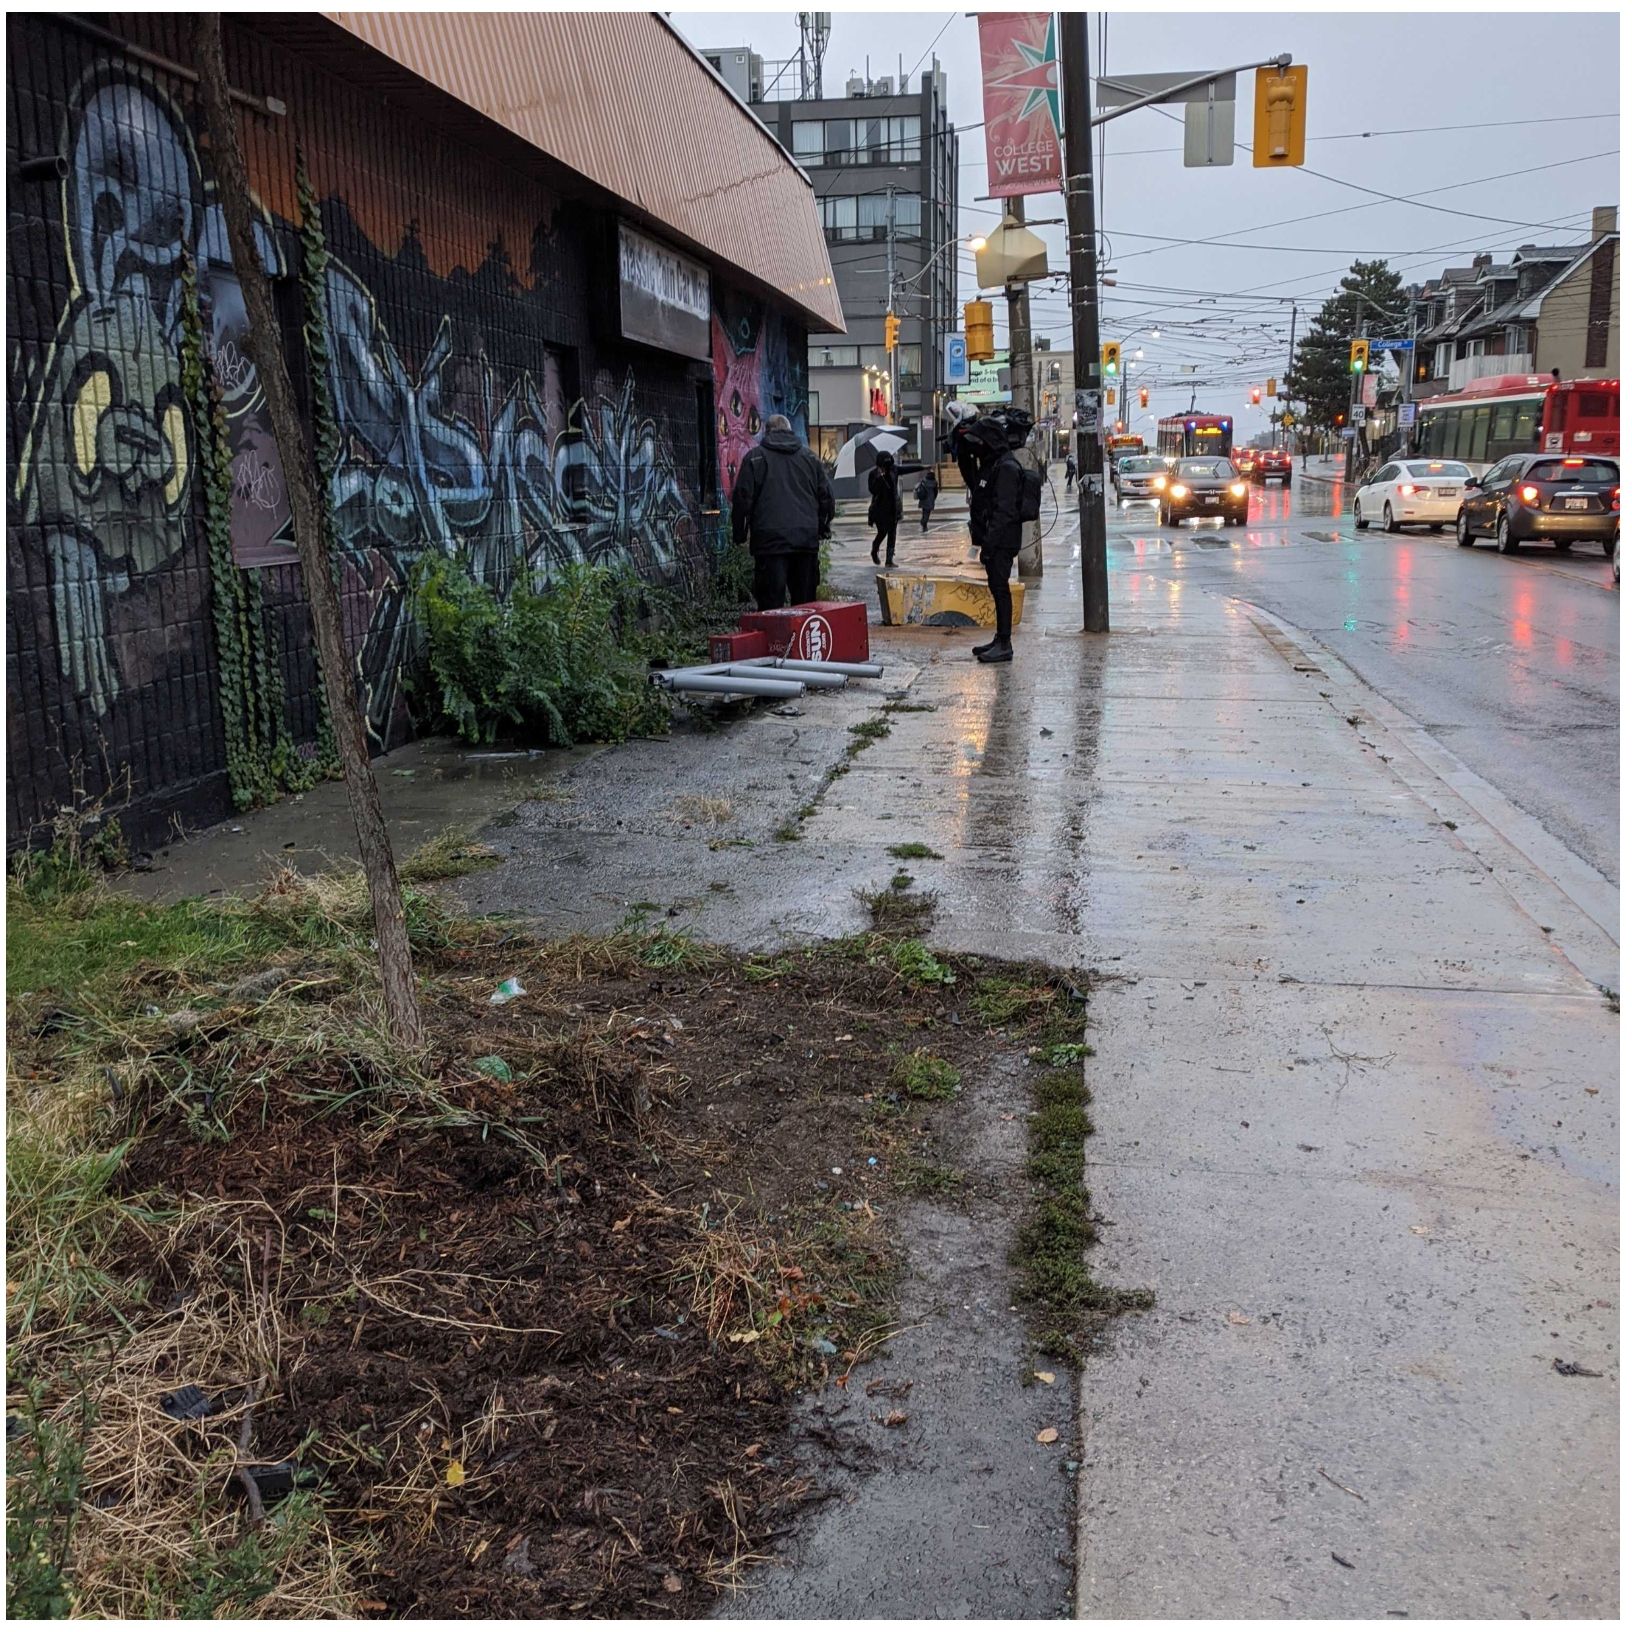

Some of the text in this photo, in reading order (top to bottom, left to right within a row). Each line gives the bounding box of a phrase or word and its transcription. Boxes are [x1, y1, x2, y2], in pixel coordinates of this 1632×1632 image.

[994, 141, 1054, 157] COLLEGE
[995, 154, 1054, 176] WEST
[1377, 339, 1402, 349] College
